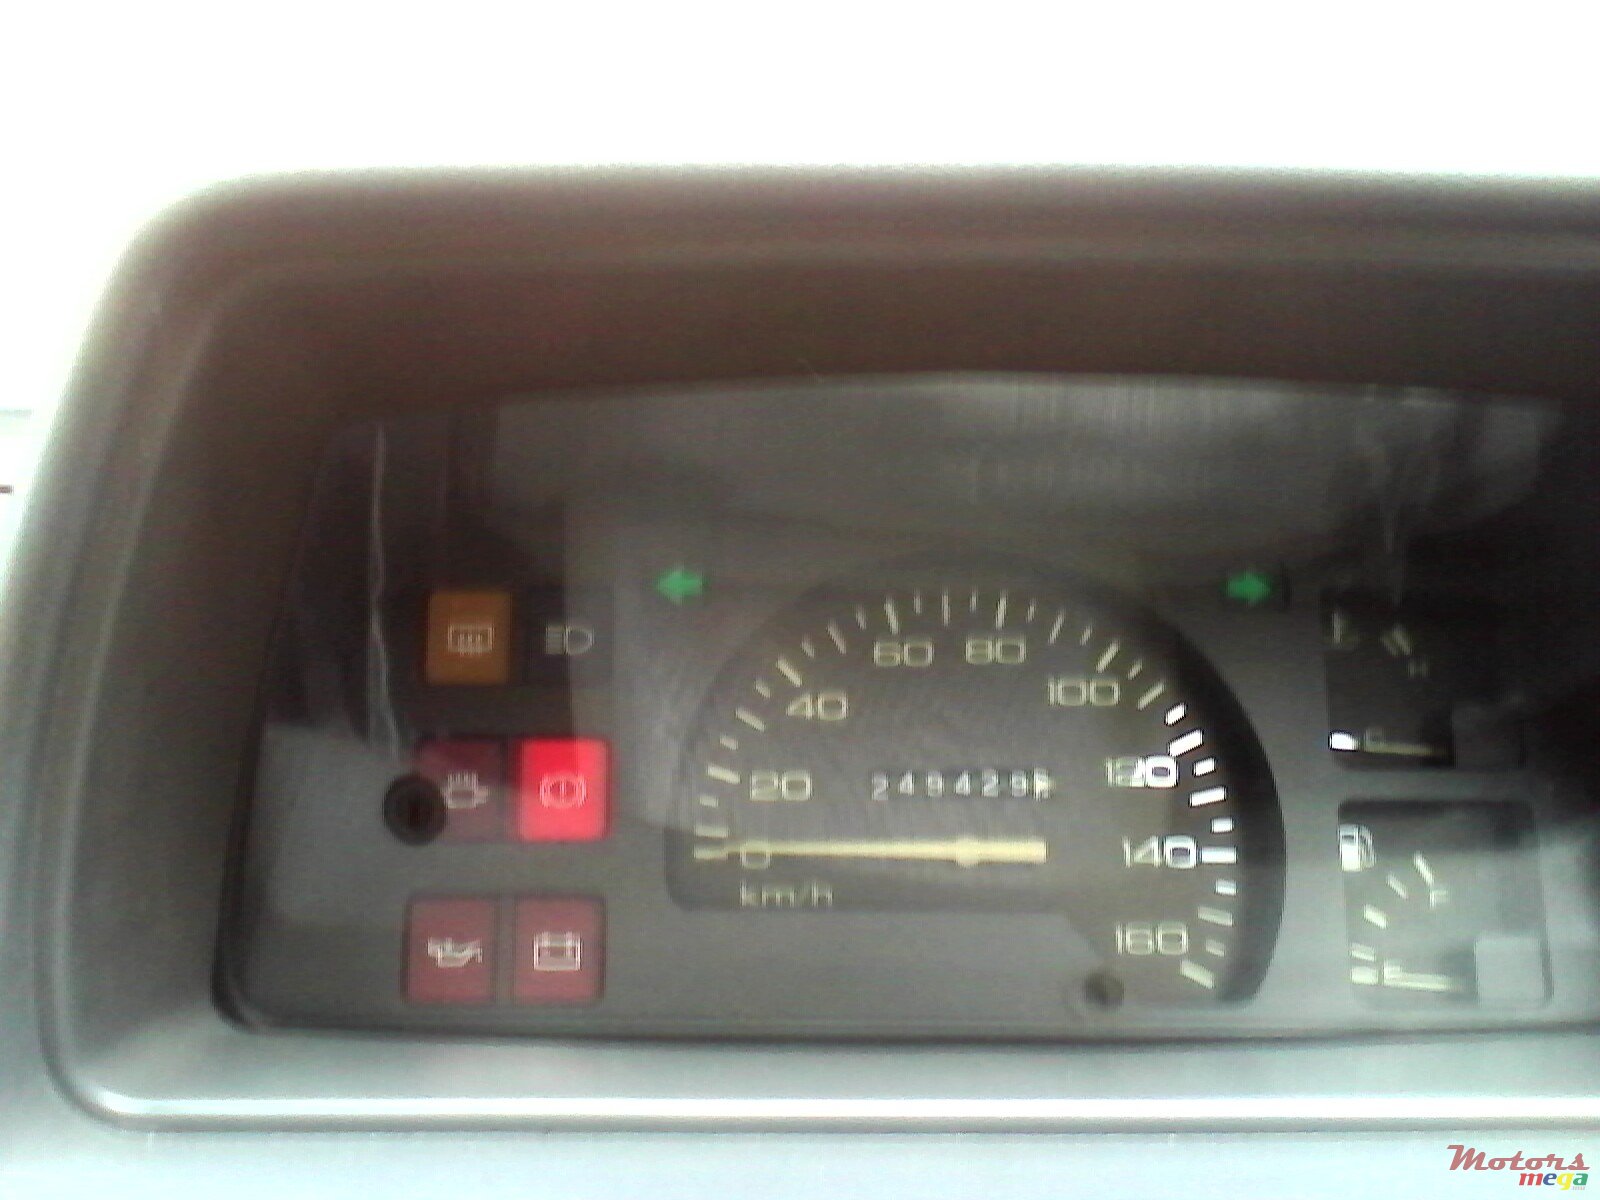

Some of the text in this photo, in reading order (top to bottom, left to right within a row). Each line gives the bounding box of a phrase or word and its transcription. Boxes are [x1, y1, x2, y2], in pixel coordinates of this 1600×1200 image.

[873, 639, 934, 667] 60
[965, 637, 1027, 665] 80
[786, 692, 848, 721] 40
[1048, 678, 1120, 706] 100
[749, 771, 812, 801] 20
[1122, 834, 1198, 870] 140
[1116, 922, 1189, 955] 160
